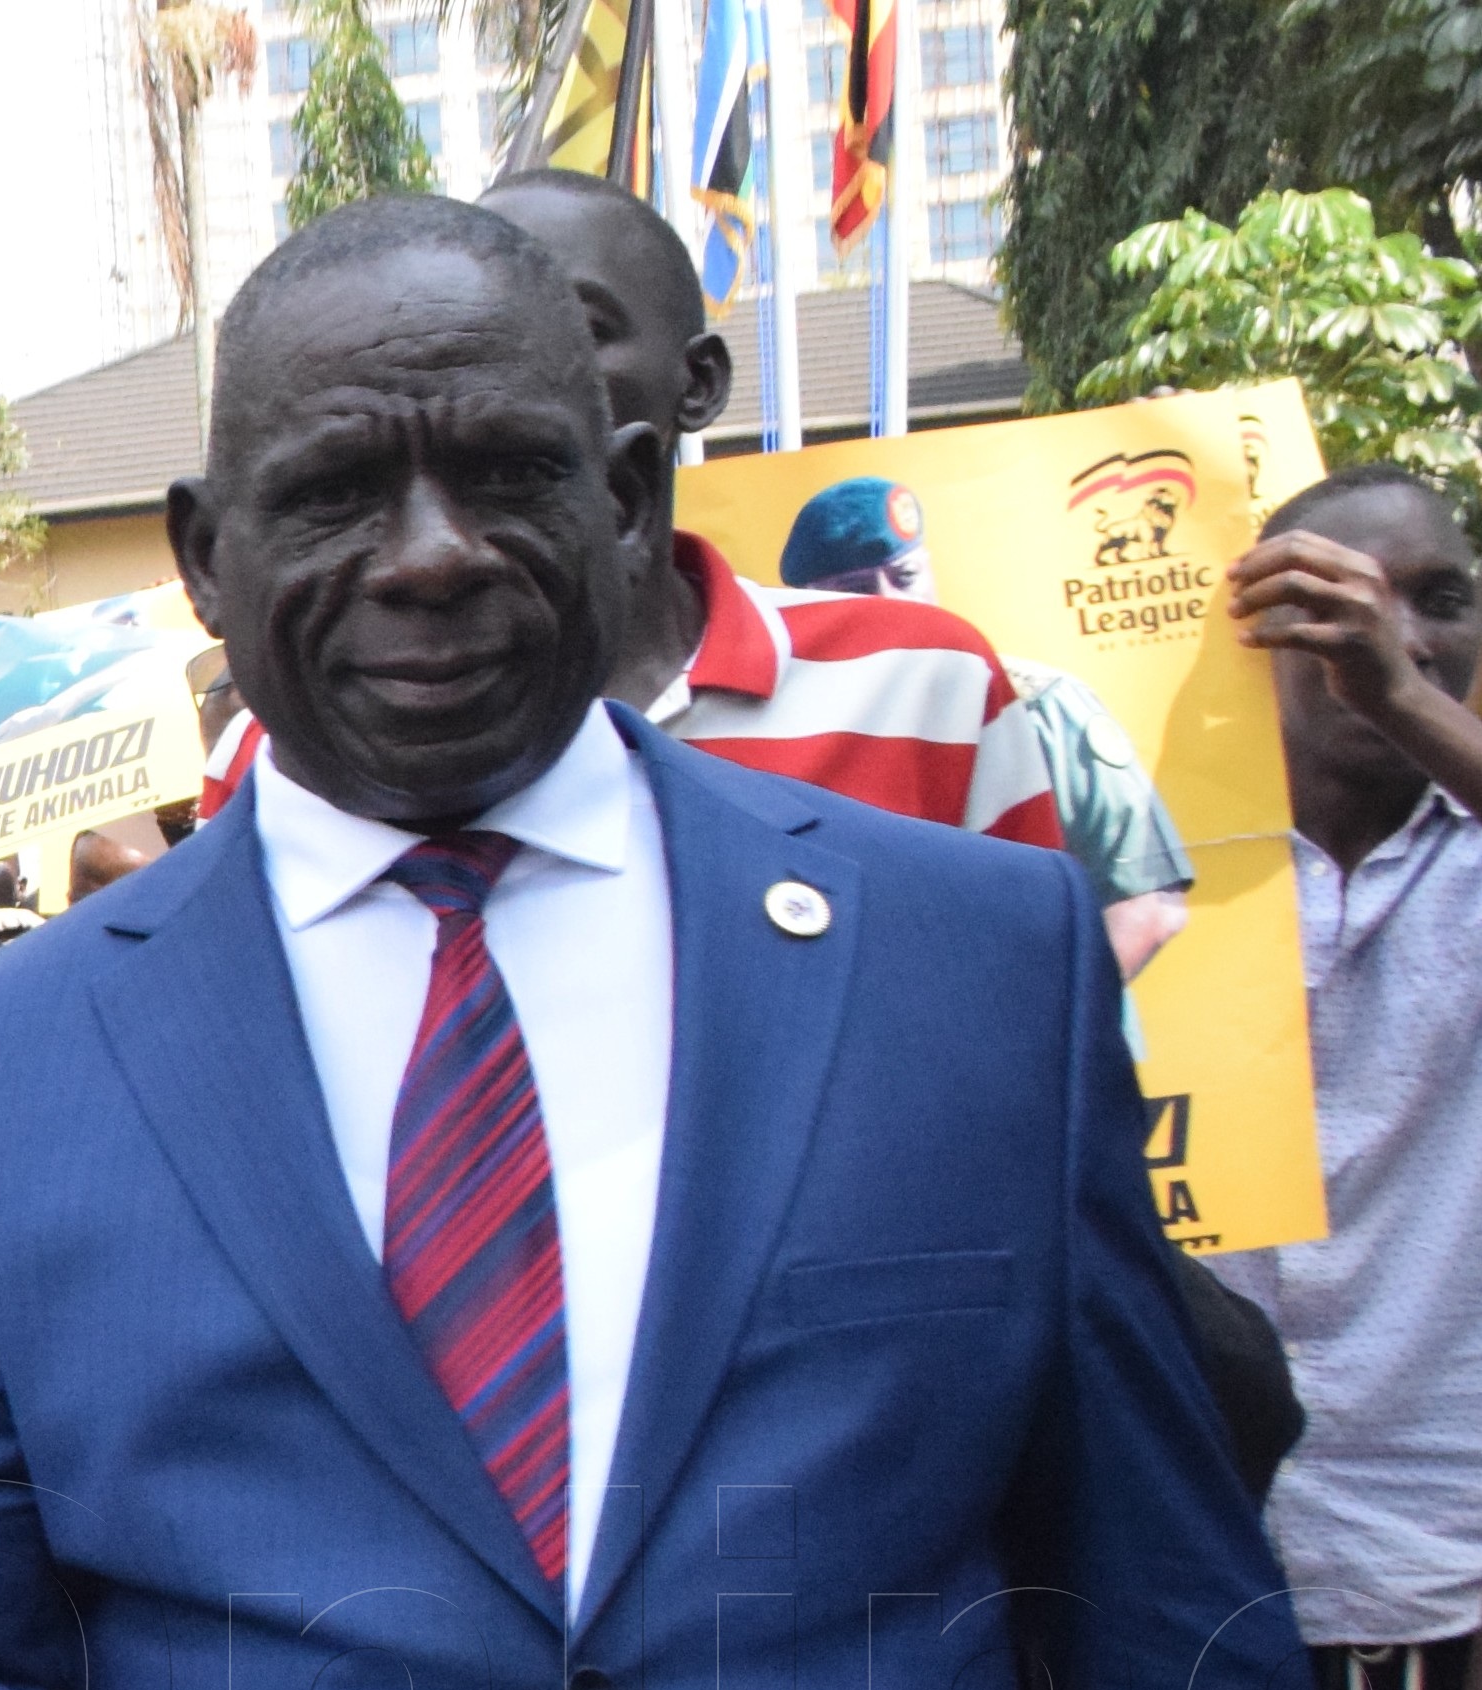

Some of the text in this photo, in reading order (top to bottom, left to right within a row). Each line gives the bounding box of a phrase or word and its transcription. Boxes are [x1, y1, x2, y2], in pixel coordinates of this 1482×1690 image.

[1063, 562, 1214, 608] Patriotic
[1078, 598, 1208, 636] League
[23, 766, 151, 830] AKIMALA
